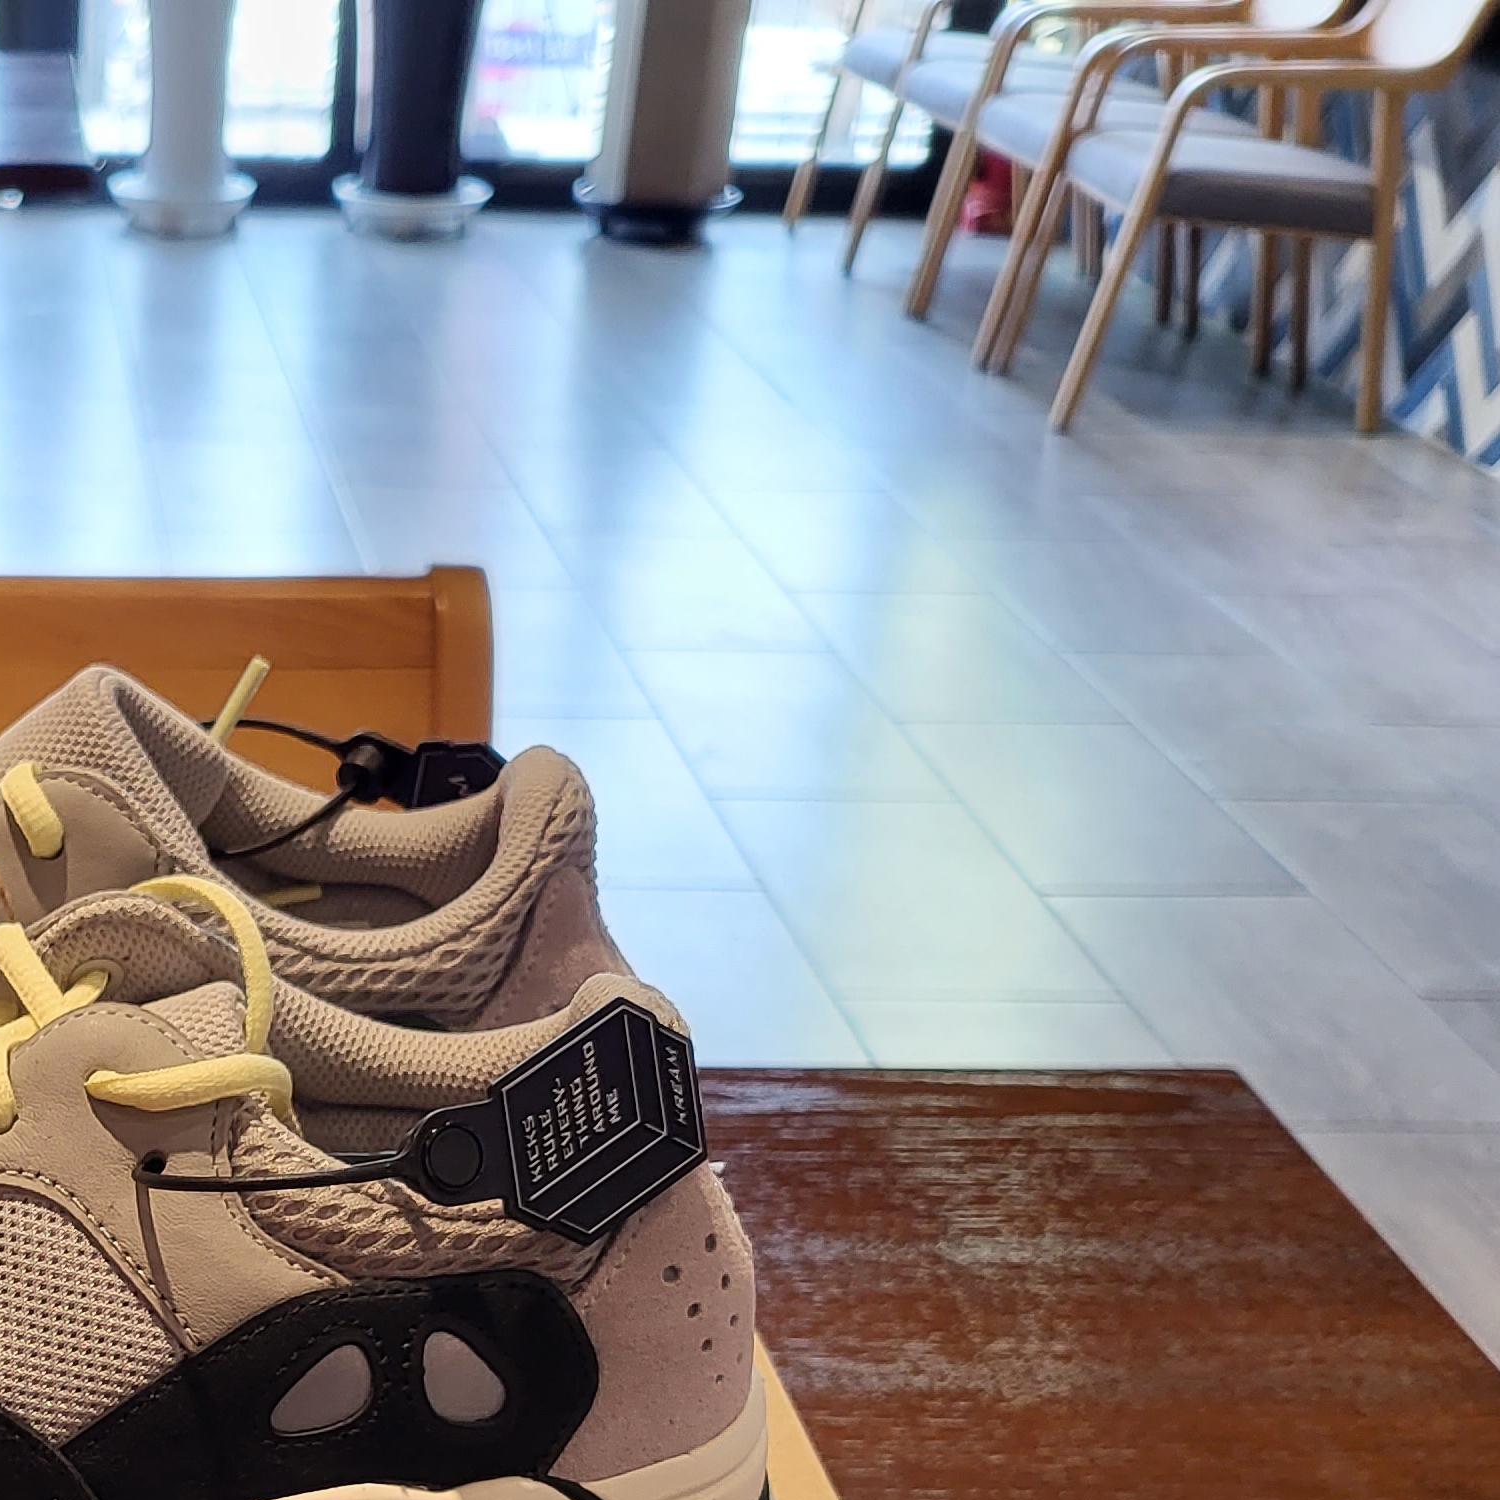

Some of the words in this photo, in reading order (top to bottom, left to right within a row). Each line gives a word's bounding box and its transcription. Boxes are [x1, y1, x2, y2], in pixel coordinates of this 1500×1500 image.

[553, 1078, 575, 1160] EVERY-
[582, 1041, 606, 1135] AROUND
[606, 1087, 623, 1124] ME
[665, 1046, 687, 1126] KREAM
[522, 1115, 543, 1183] KICKS
[538, 1108, 560, 1172] RULE
